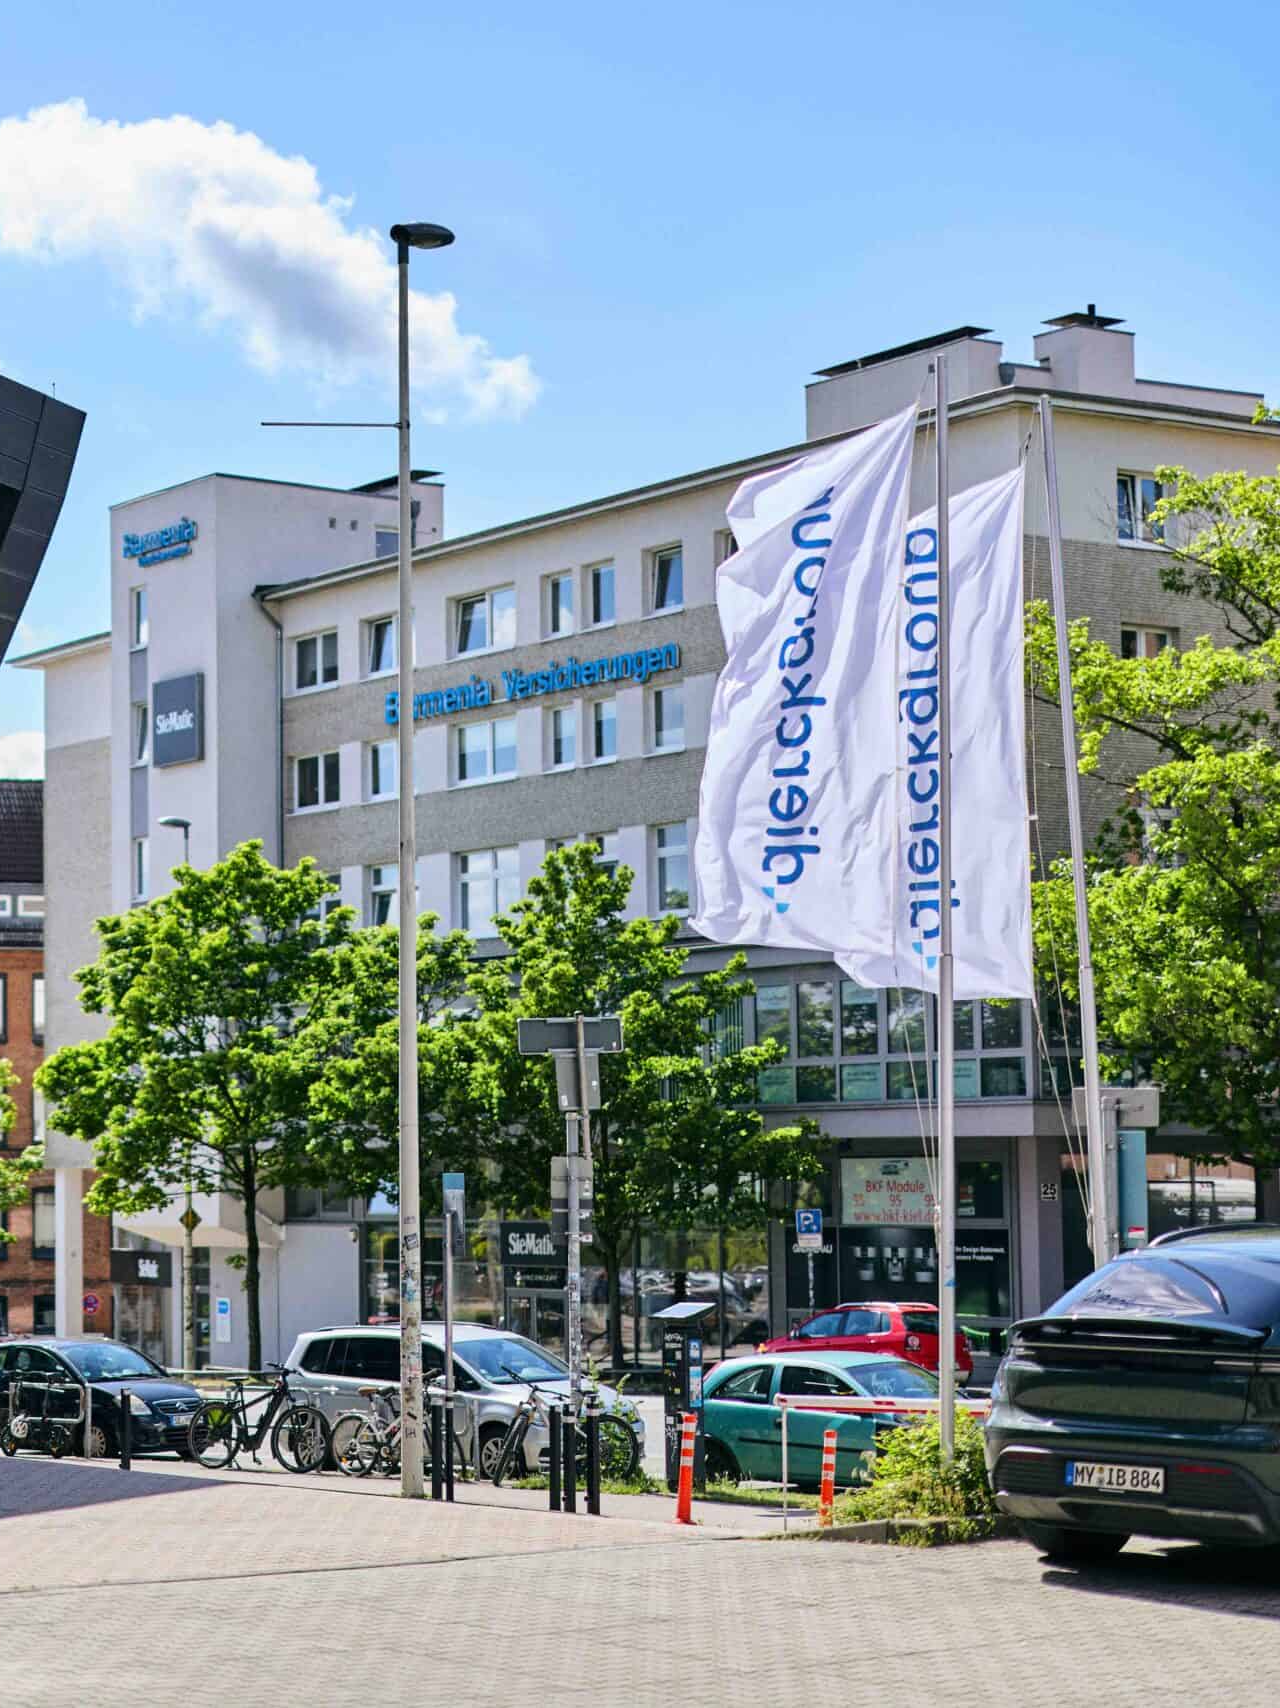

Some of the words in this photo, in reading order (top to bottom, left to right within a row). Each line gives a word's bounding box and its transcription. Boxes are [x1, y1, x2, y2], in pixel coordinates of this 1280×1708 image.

[384, 674, 493, 726] Brmenia
[501, 641, 681, 701] Versicherungen
[865, 1181, 883, 1193] BKF
[886, 1180, 926, 1193] Module
[1042, 1183, 1057, 1196] 25
[1075, 1465, 1095, 1484] MY
[1107, 1468, 1126, 1486] IB
[1130, 1470, 1161, 1488] 884
